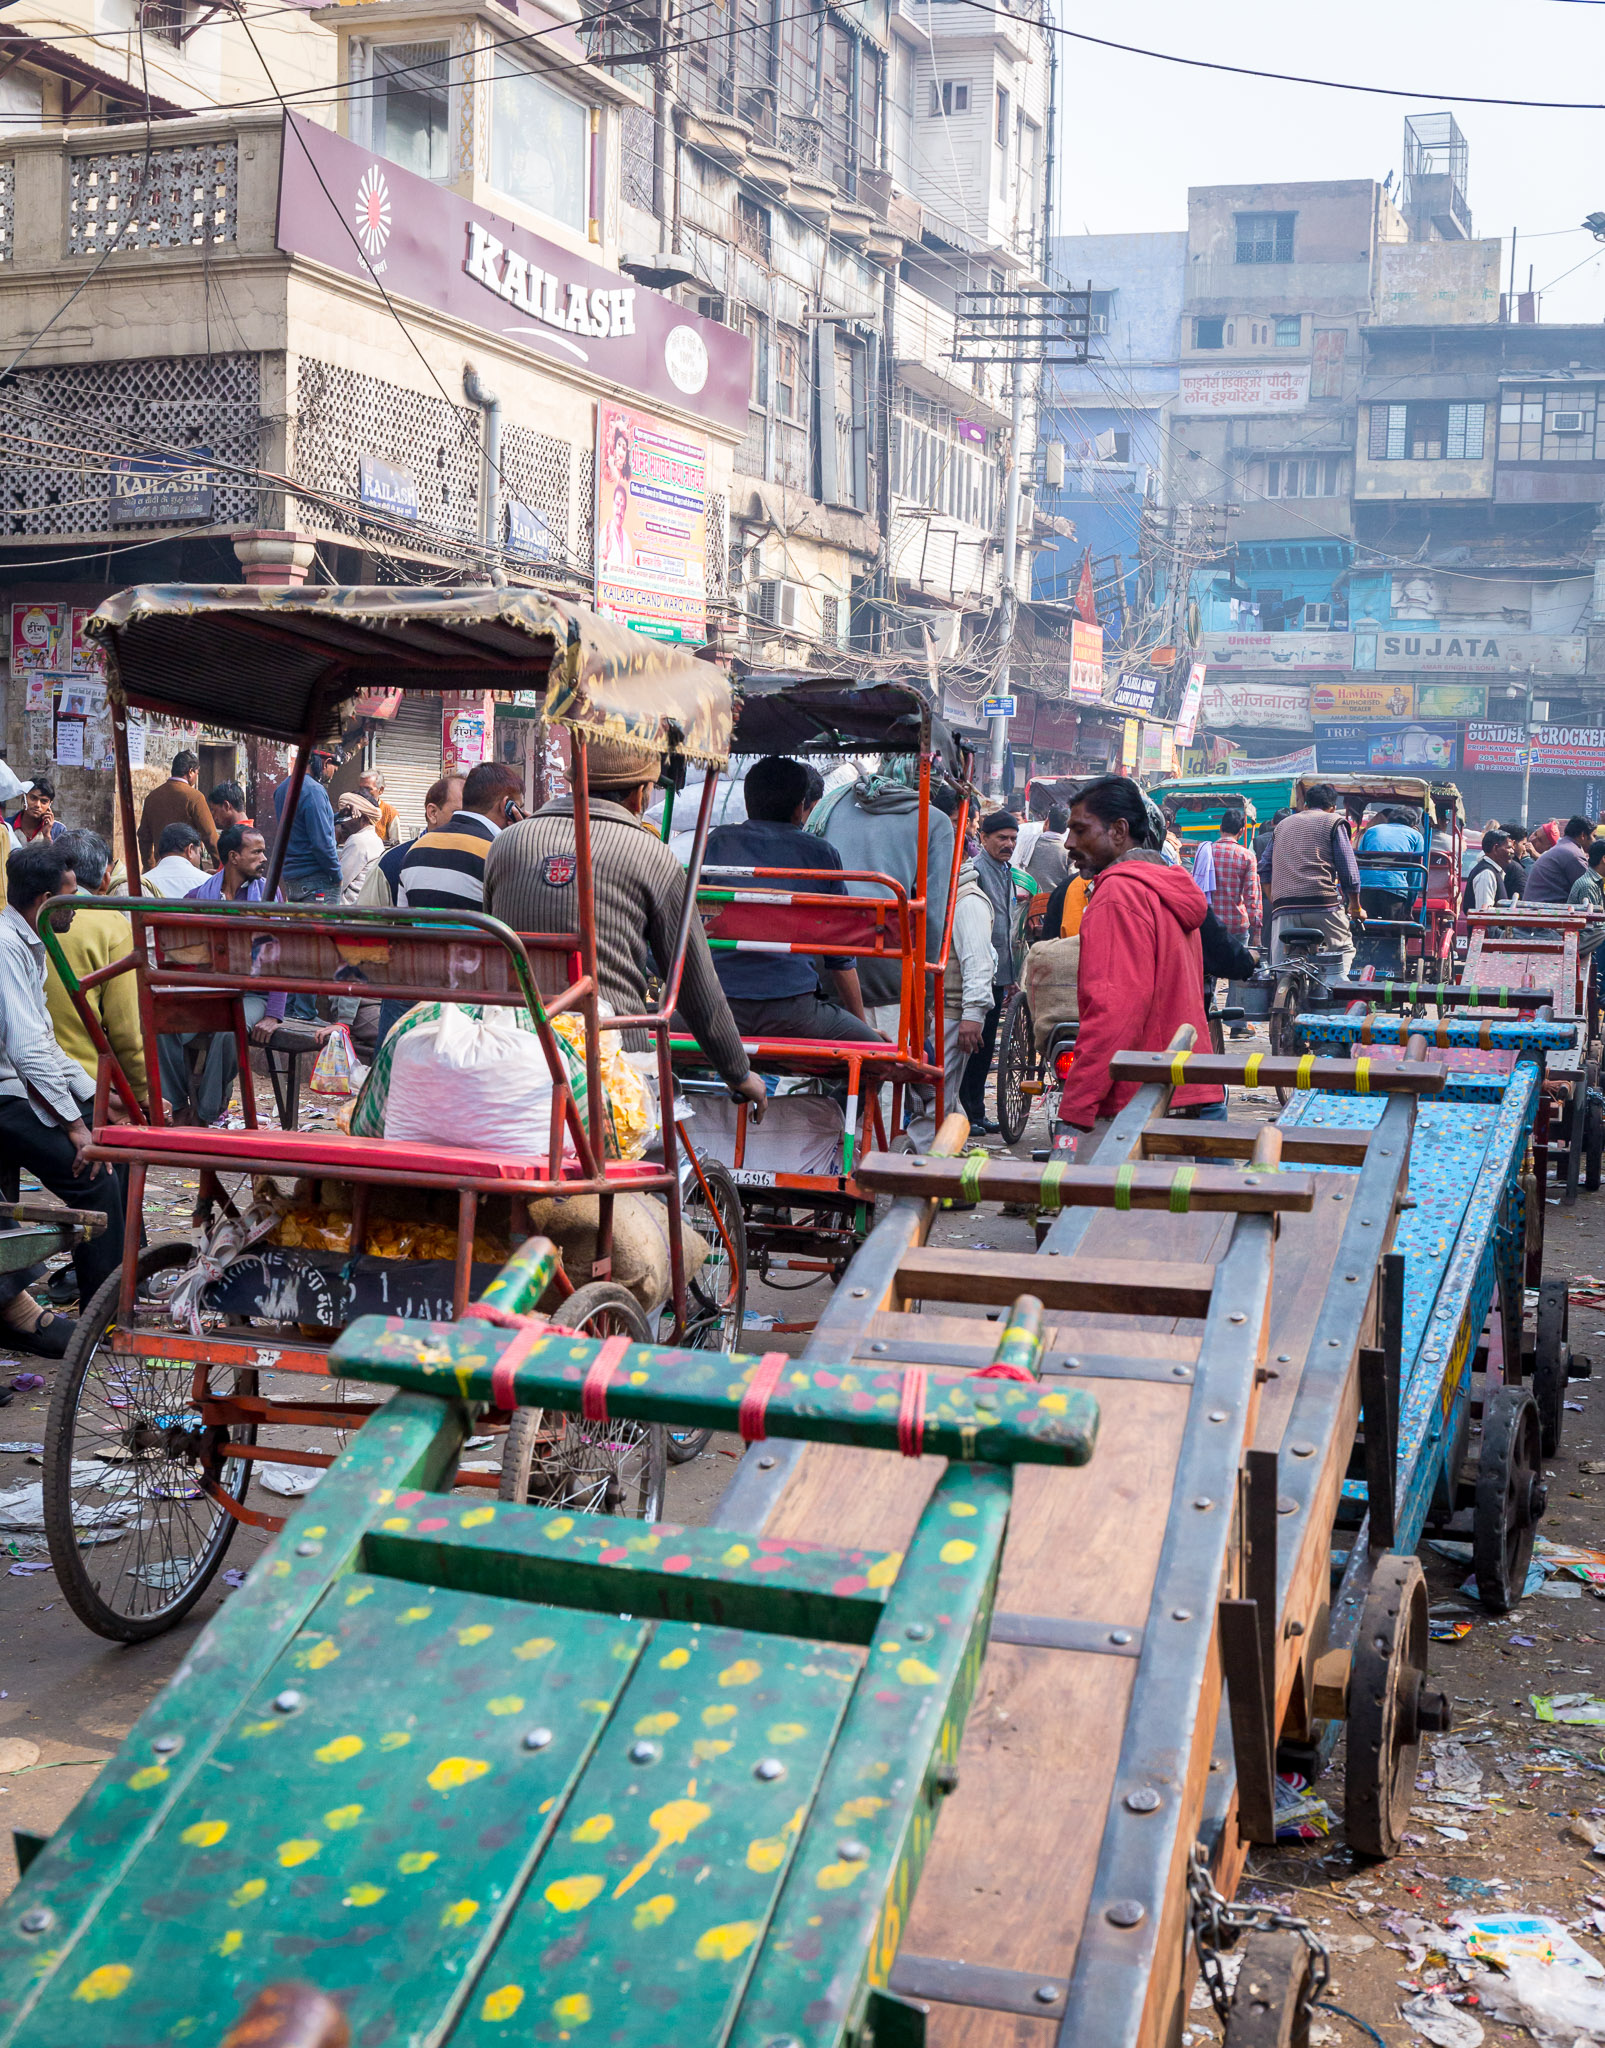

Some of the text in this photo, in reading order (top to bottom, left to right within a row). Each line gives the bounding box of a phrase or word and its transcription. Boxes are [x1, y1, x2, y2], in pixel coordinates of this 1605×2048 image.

[465, 220, 636, 338] KAILASH
[115, 471, 208, 496] KAILASH
[364, 473, 416, 507] KAILASH
[511, 516, 548, 549] KAILASH
[603, 584, 634, 605] KAILASH
[636, 590, 661, 608] CHAND
[663, 596, 683, 612] WARQ
[685, 601, 702, 614] WALA
[26, 621, 45, 634] हींग
[1228, 635, 1271, 646] United
[1384, 637, 1500, 657] SUJATA
[1232, 687, 1310, 711] भोजनालय
[1338, 688, 1383, 699] Hawkins
[1468, 722, 1526, 744] SUNDEE
[1479, 754, 1497, 762] 205,
[1545, 758, 1577, 767] CHOWK,
[549, 867, 570, 882] 82
